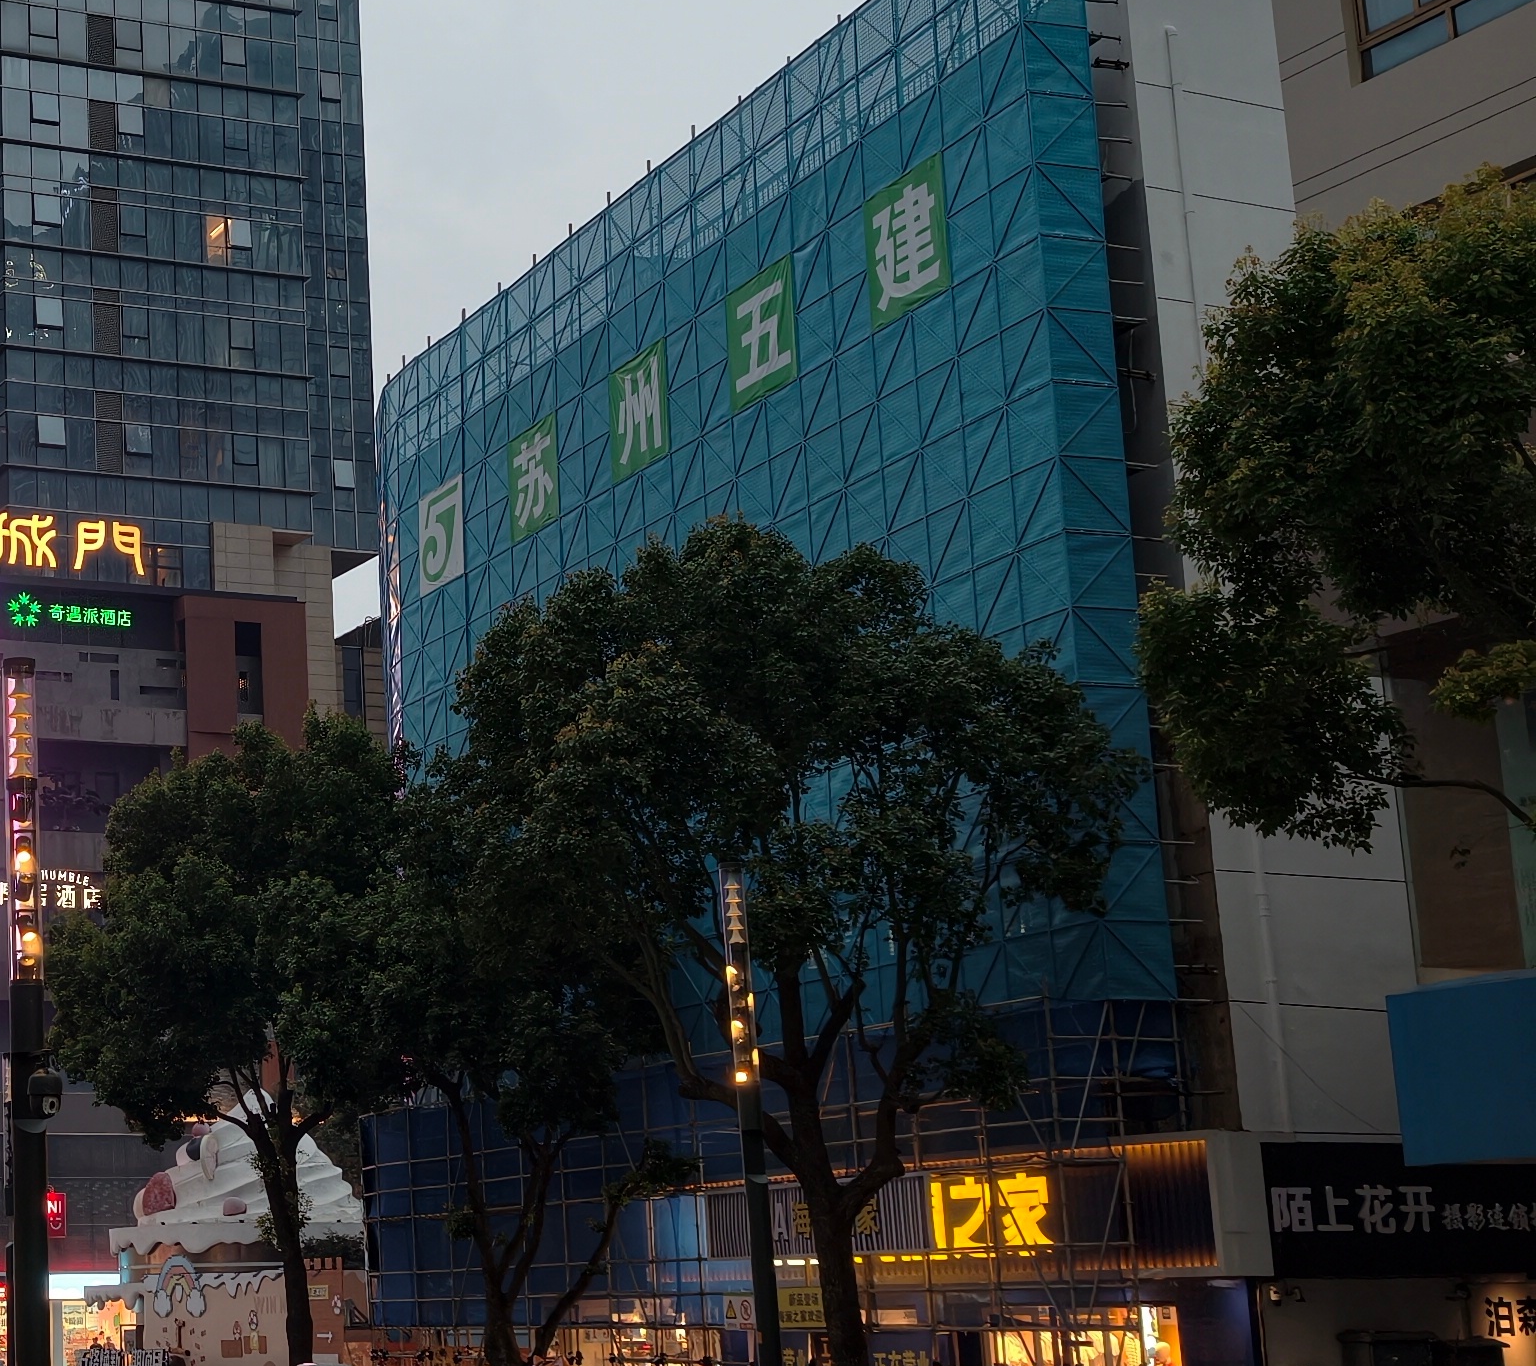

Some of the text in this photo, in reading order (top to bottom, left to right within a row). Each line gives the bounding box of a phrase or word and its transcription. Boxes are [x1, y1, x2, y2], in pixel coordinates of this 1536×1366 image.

[513, 181, 943, 528] 苏州五建
[49, 603, 132, 628] 奇遇派酒店
[930, 1172, 1055, 1250] 之家
[1270, 1184, 1436, 1234] 陌上花开
